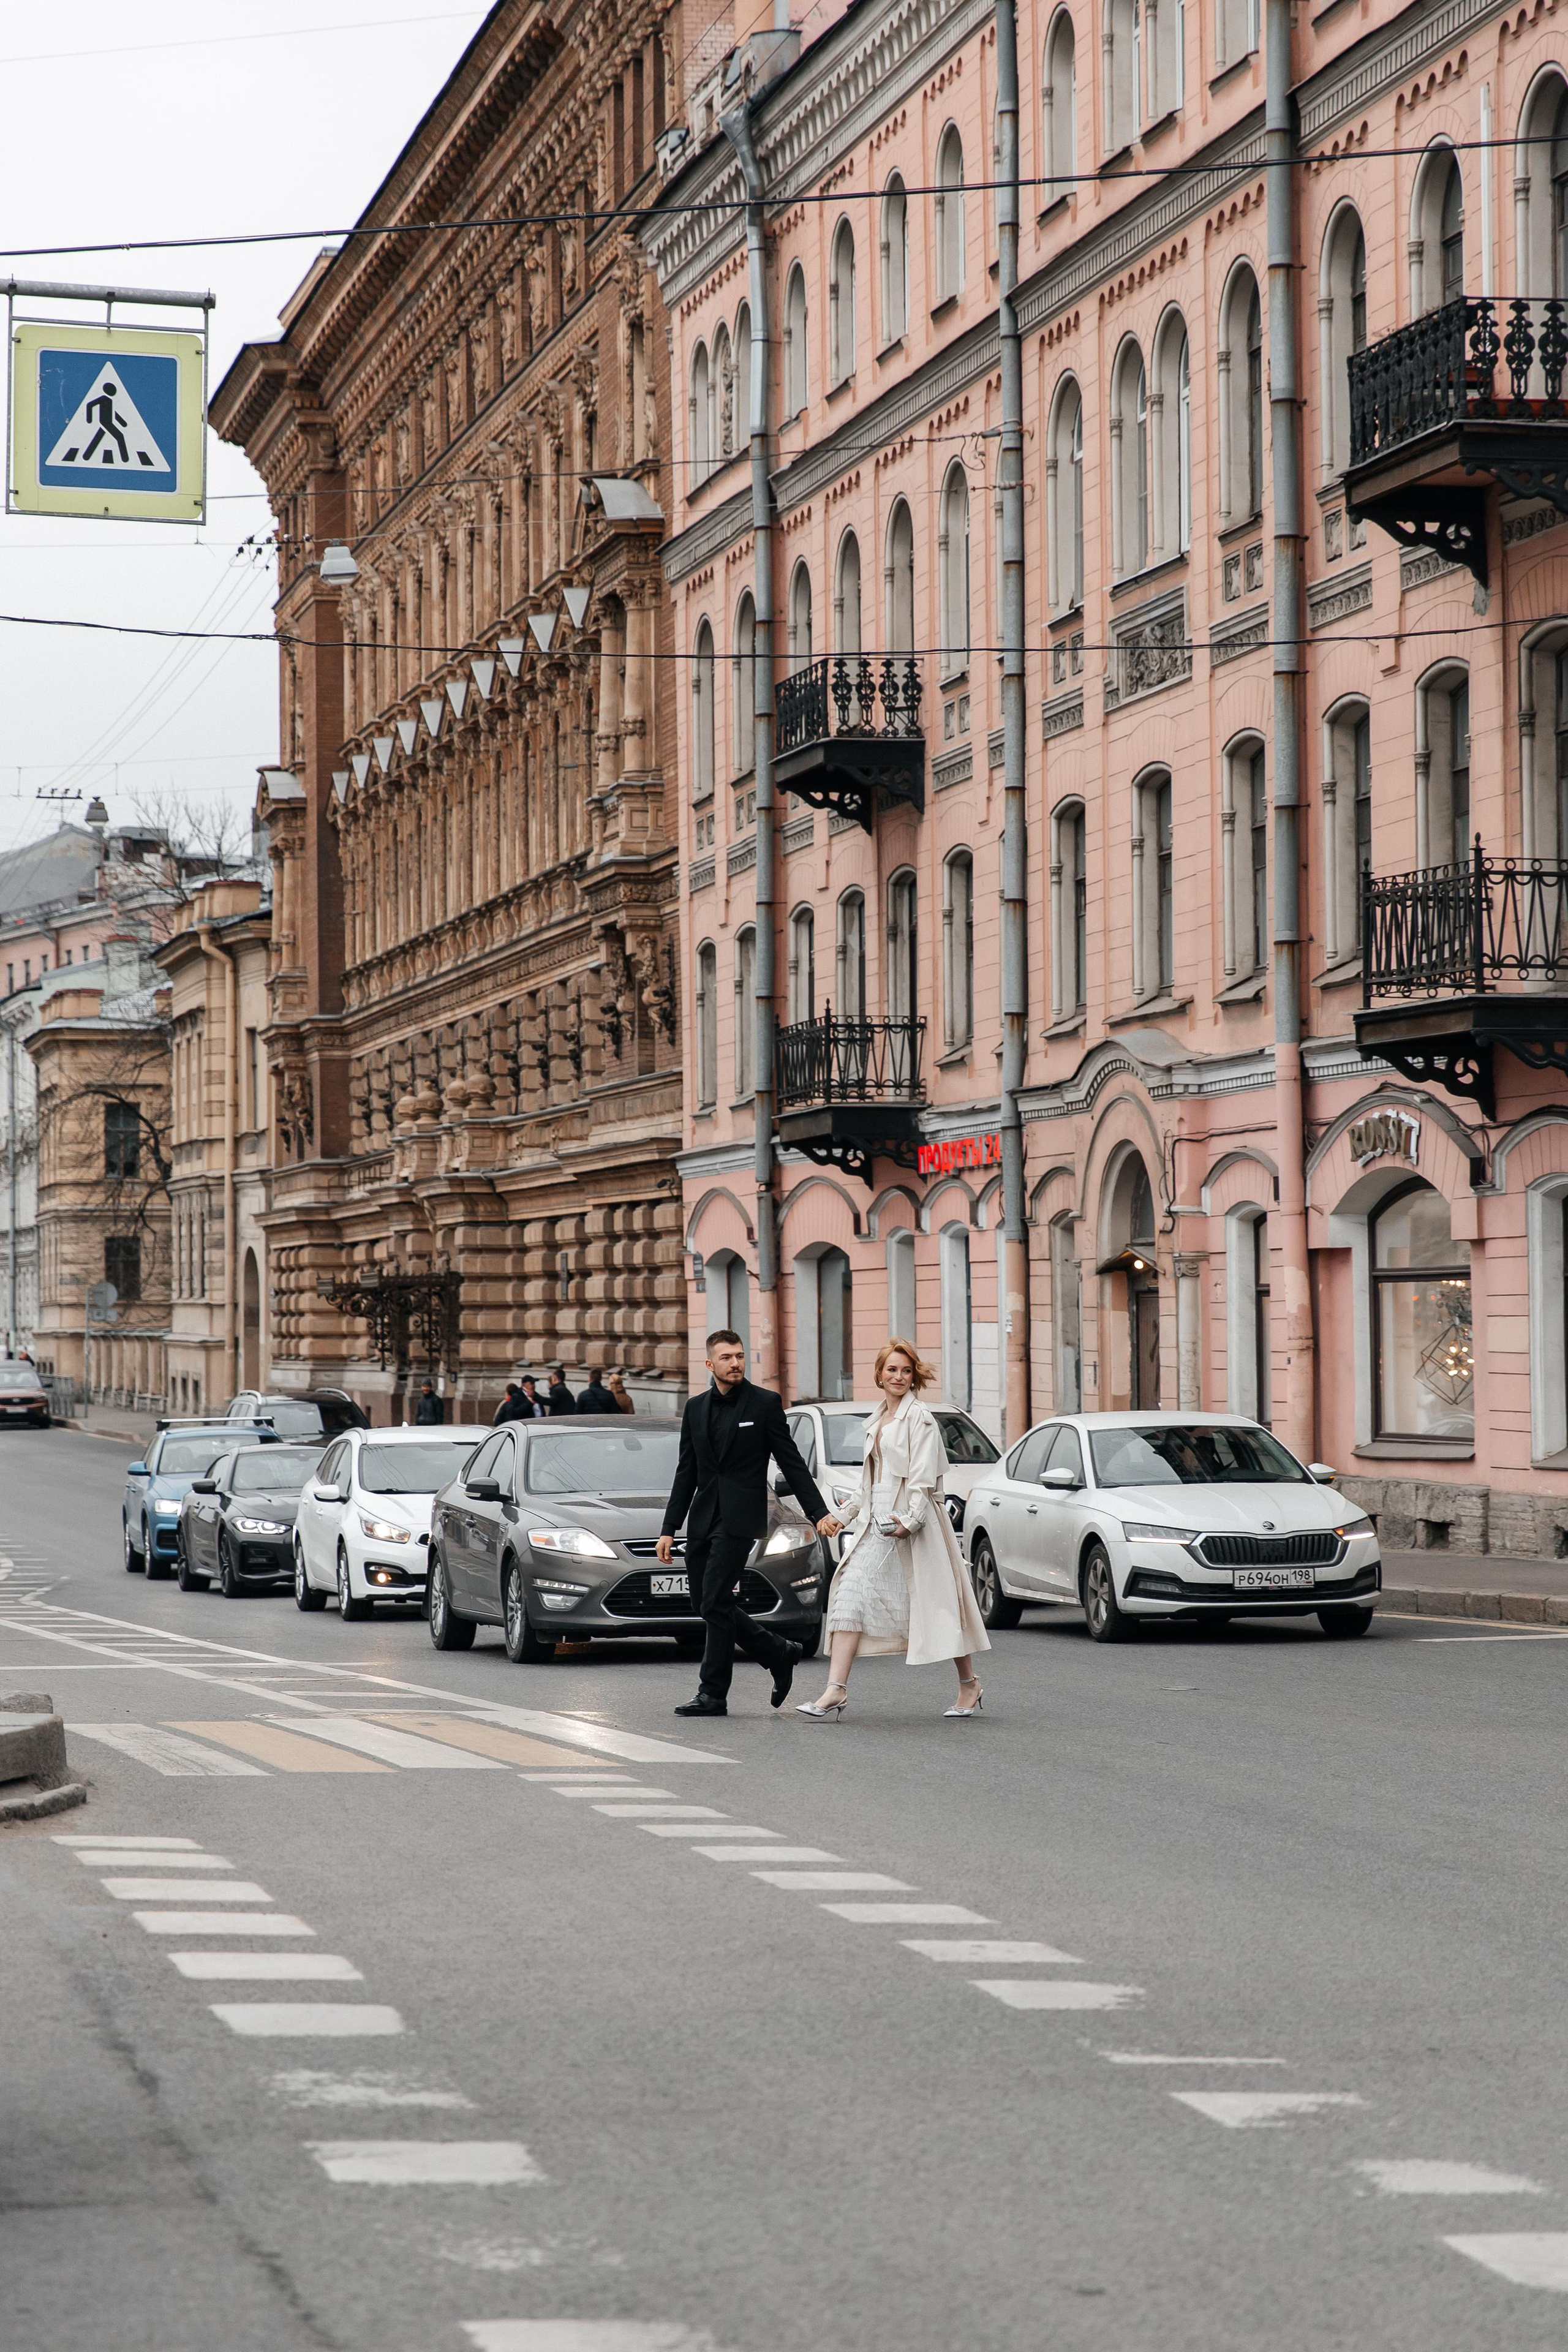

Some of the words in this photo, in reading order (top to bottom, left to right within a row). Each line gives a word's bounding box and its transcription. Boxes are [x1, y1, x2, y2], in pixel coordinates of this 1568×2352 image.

[918, 1136, 982, 1175] ПРОДУКТЫ
[985, 1133, 1001, 1163] 24
[1291, 1570, 1310, 1580] 198
